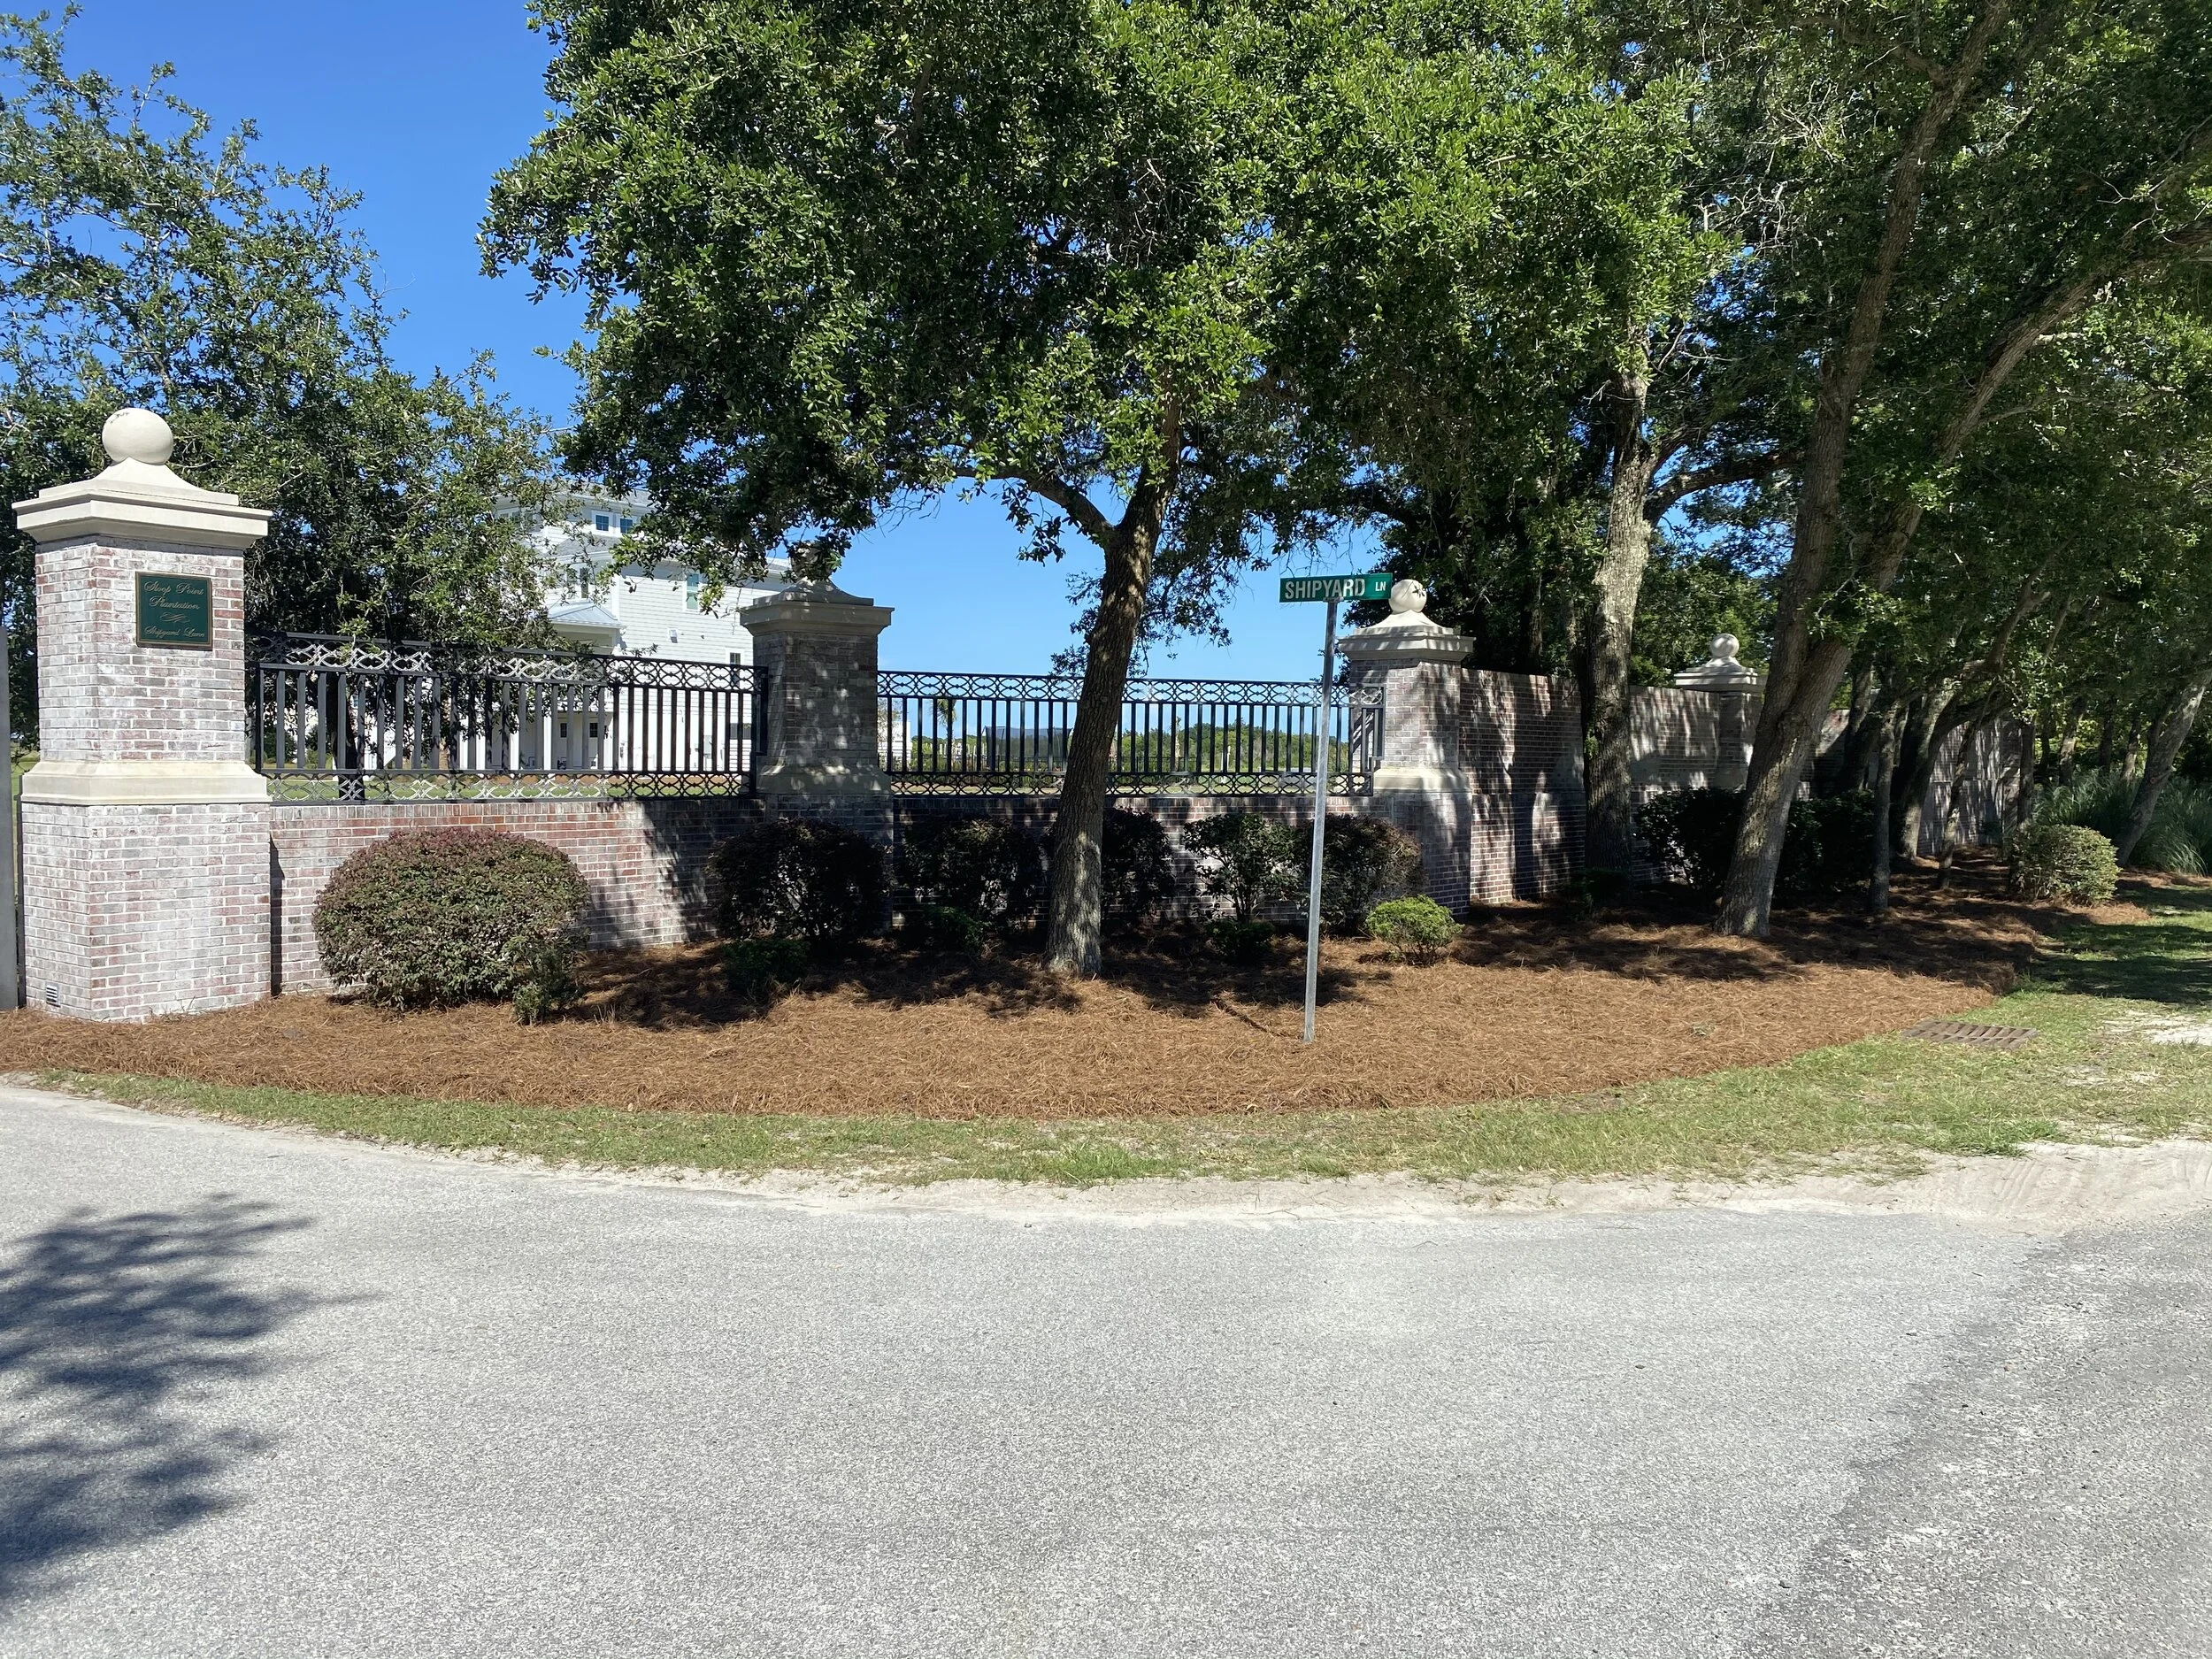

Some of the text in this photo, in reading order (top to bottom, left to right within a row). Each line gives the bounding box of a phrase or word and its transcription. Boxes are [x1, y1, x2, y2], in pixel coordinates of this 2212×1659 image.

[144, 580, 204, 595] Sloop Point
[1285, 579, 1386, 599] SHIPYARD LN
[149, 595, 200, 610] Plantation
